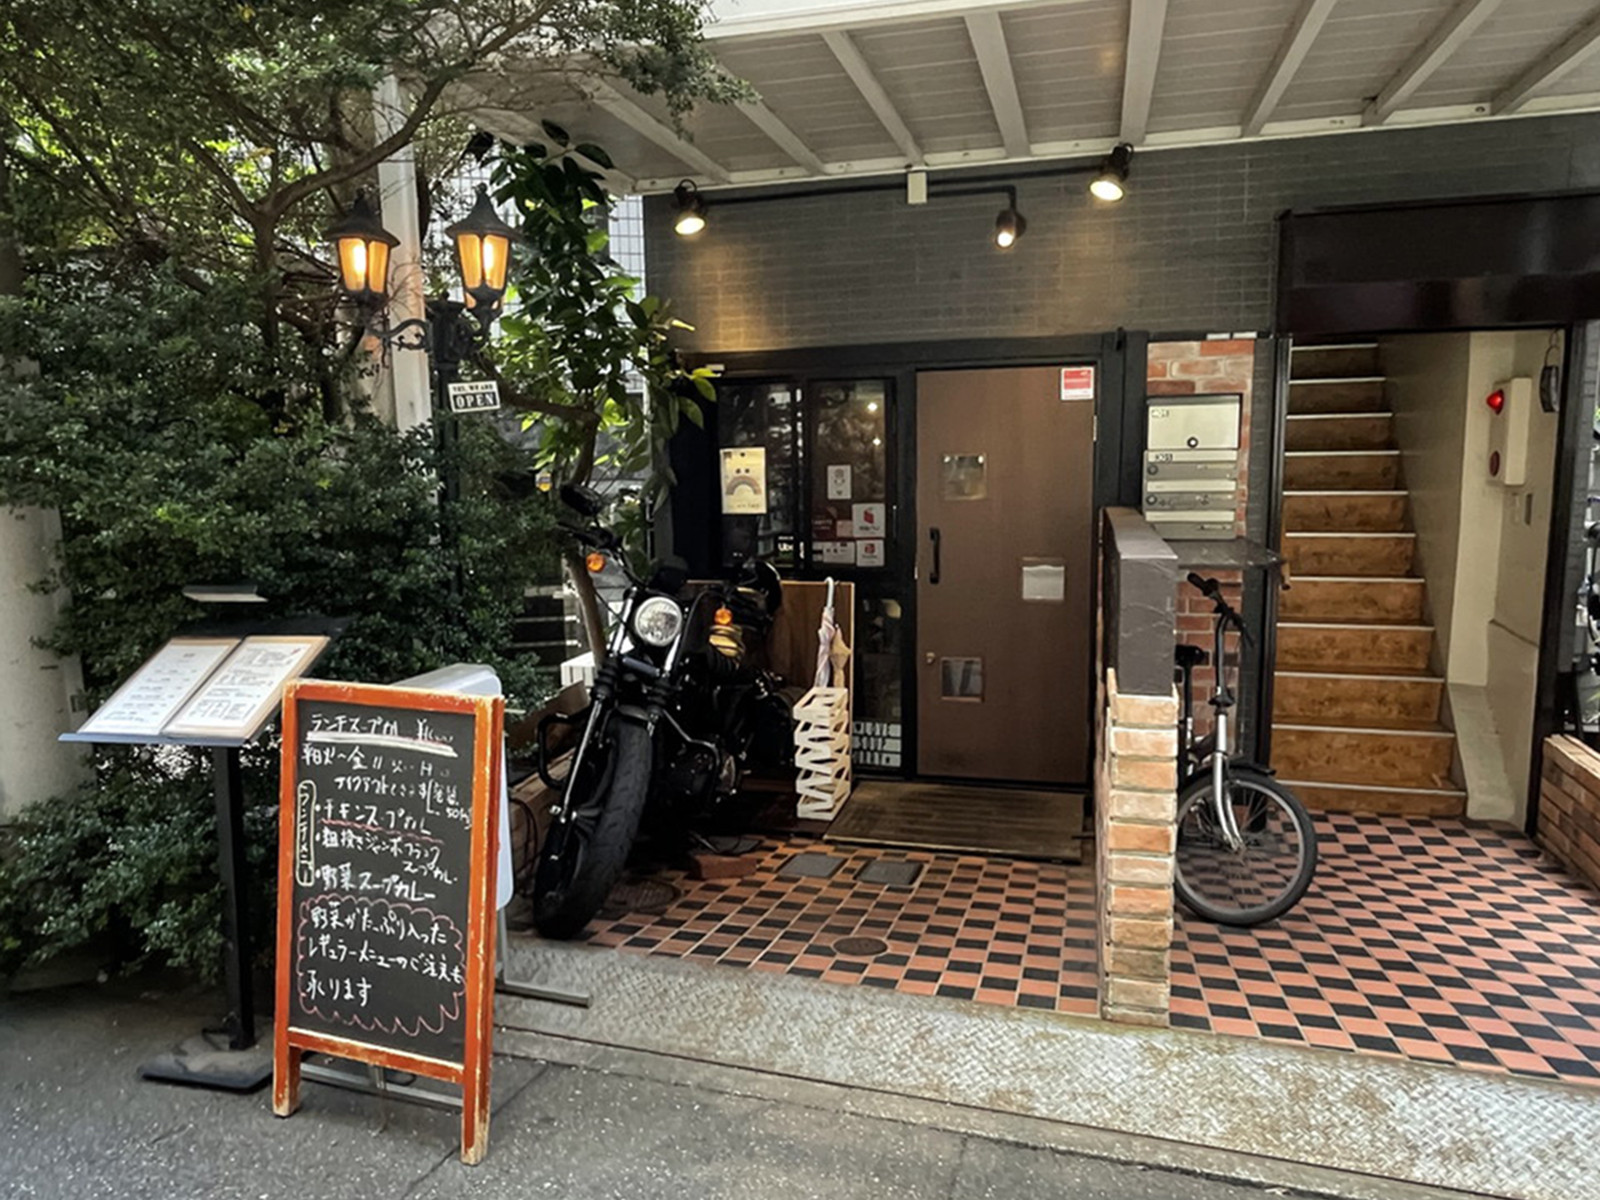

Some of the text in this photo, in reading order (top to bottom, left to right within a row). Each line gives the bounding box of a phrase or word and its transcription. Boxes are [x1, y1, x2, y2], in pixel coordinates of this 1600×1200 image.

[456, 393, 494, 408] OPEN
[306, 969, 373, 1007] 承ります
